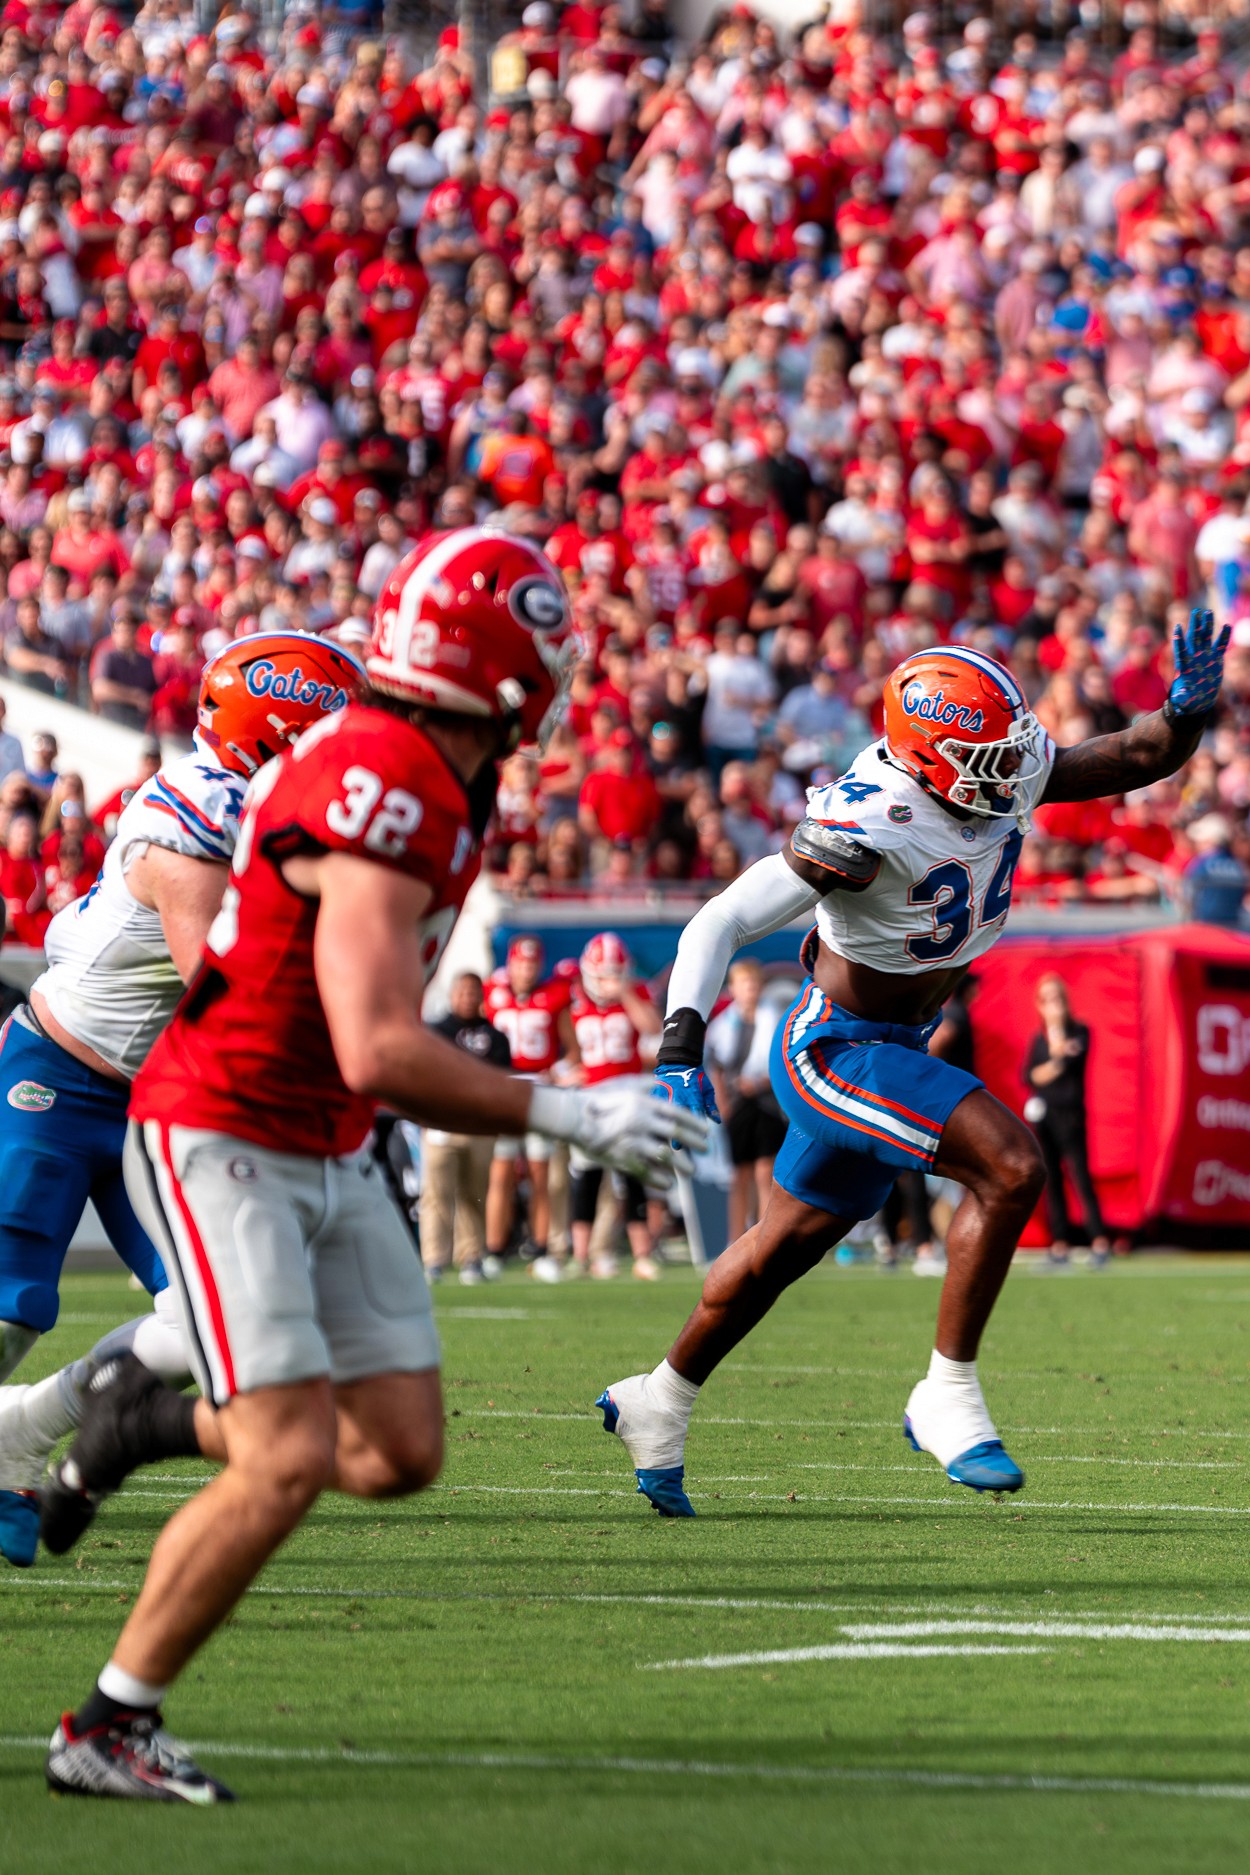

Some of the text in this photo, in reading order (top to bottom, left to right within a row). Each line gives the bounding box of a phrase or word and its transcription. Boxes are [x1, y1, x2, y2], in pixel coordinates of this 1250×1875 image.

[246, 660, 349, 712] Gators
[902, 681, 984, 733] Gators
[325, 764, 424, 857] 32
[903, 827, 1023, 963] 34
